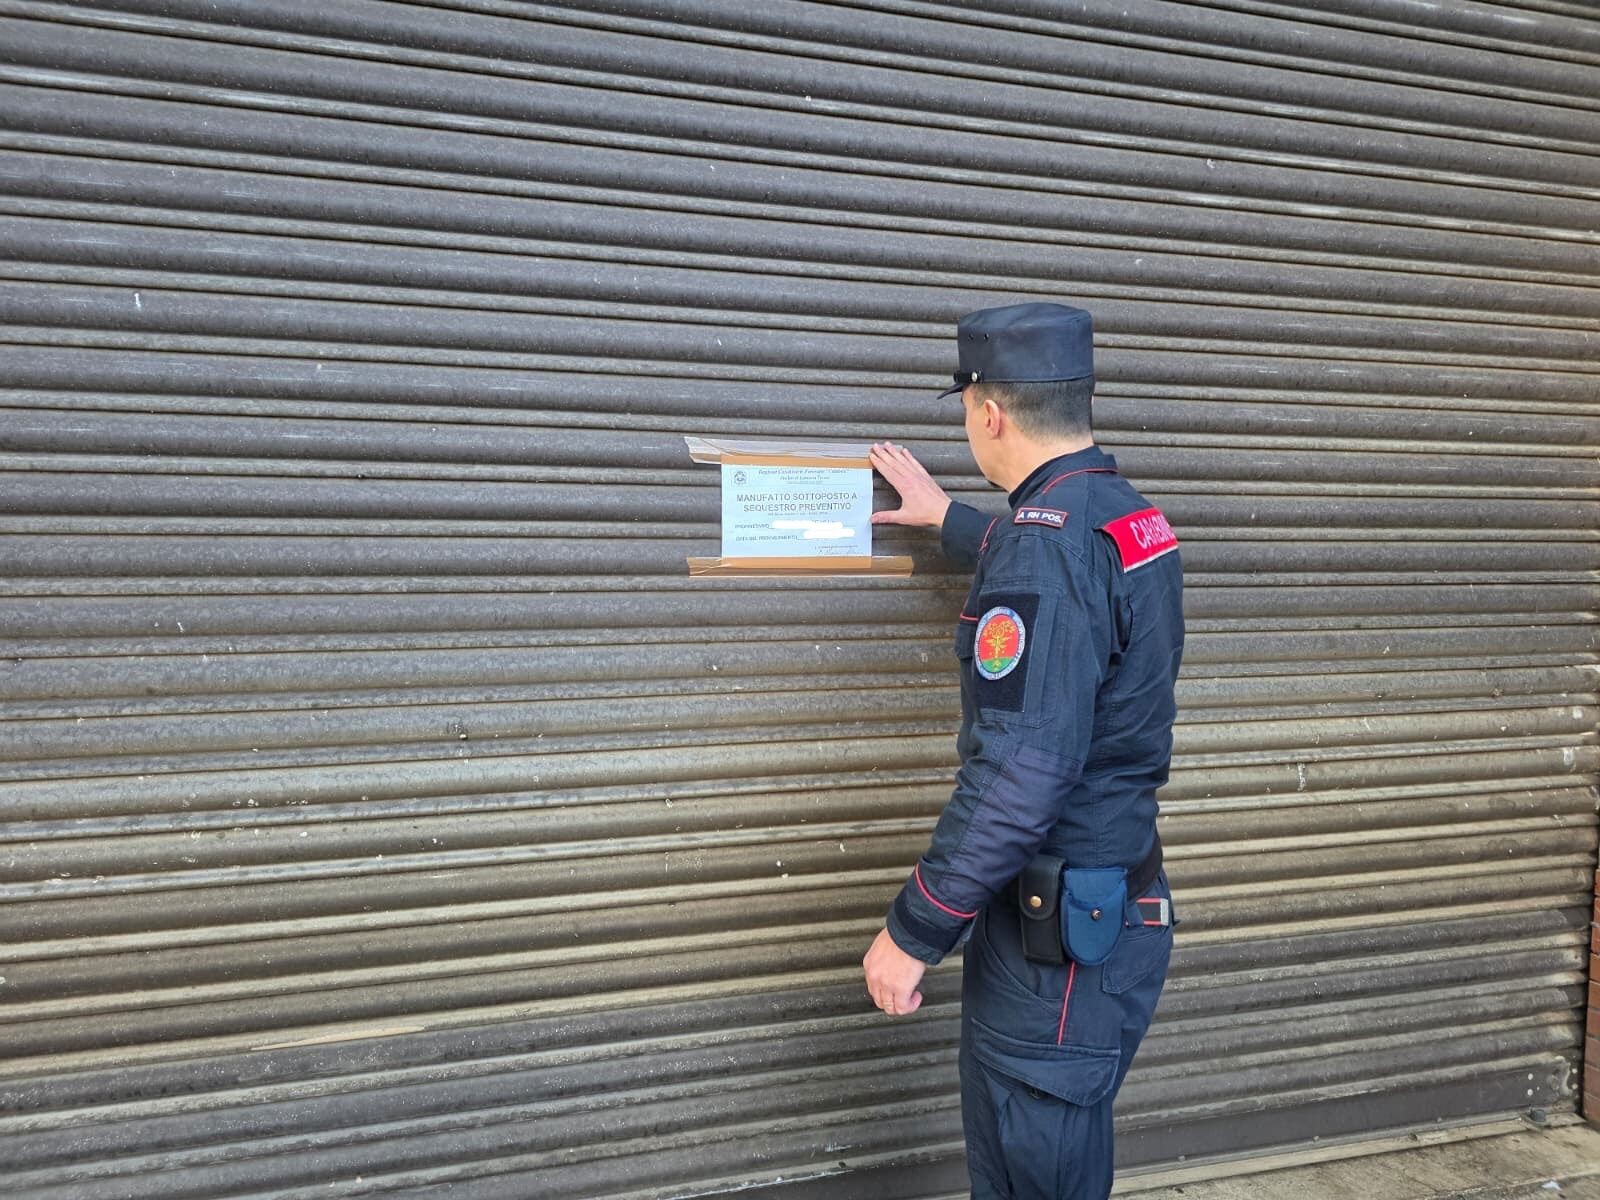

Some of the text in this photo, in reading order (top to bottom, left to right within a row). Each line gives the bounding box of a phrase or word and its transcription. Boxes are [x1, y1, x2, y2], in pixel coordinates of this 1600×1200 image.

[736, 492, 858, 502] MANUFATTO SOTTOPOSTO A
[743, 502, 852, 512] SEQUESTRO PREVENTIVO
[1018, 511, 1062, 523] A RH POS.
